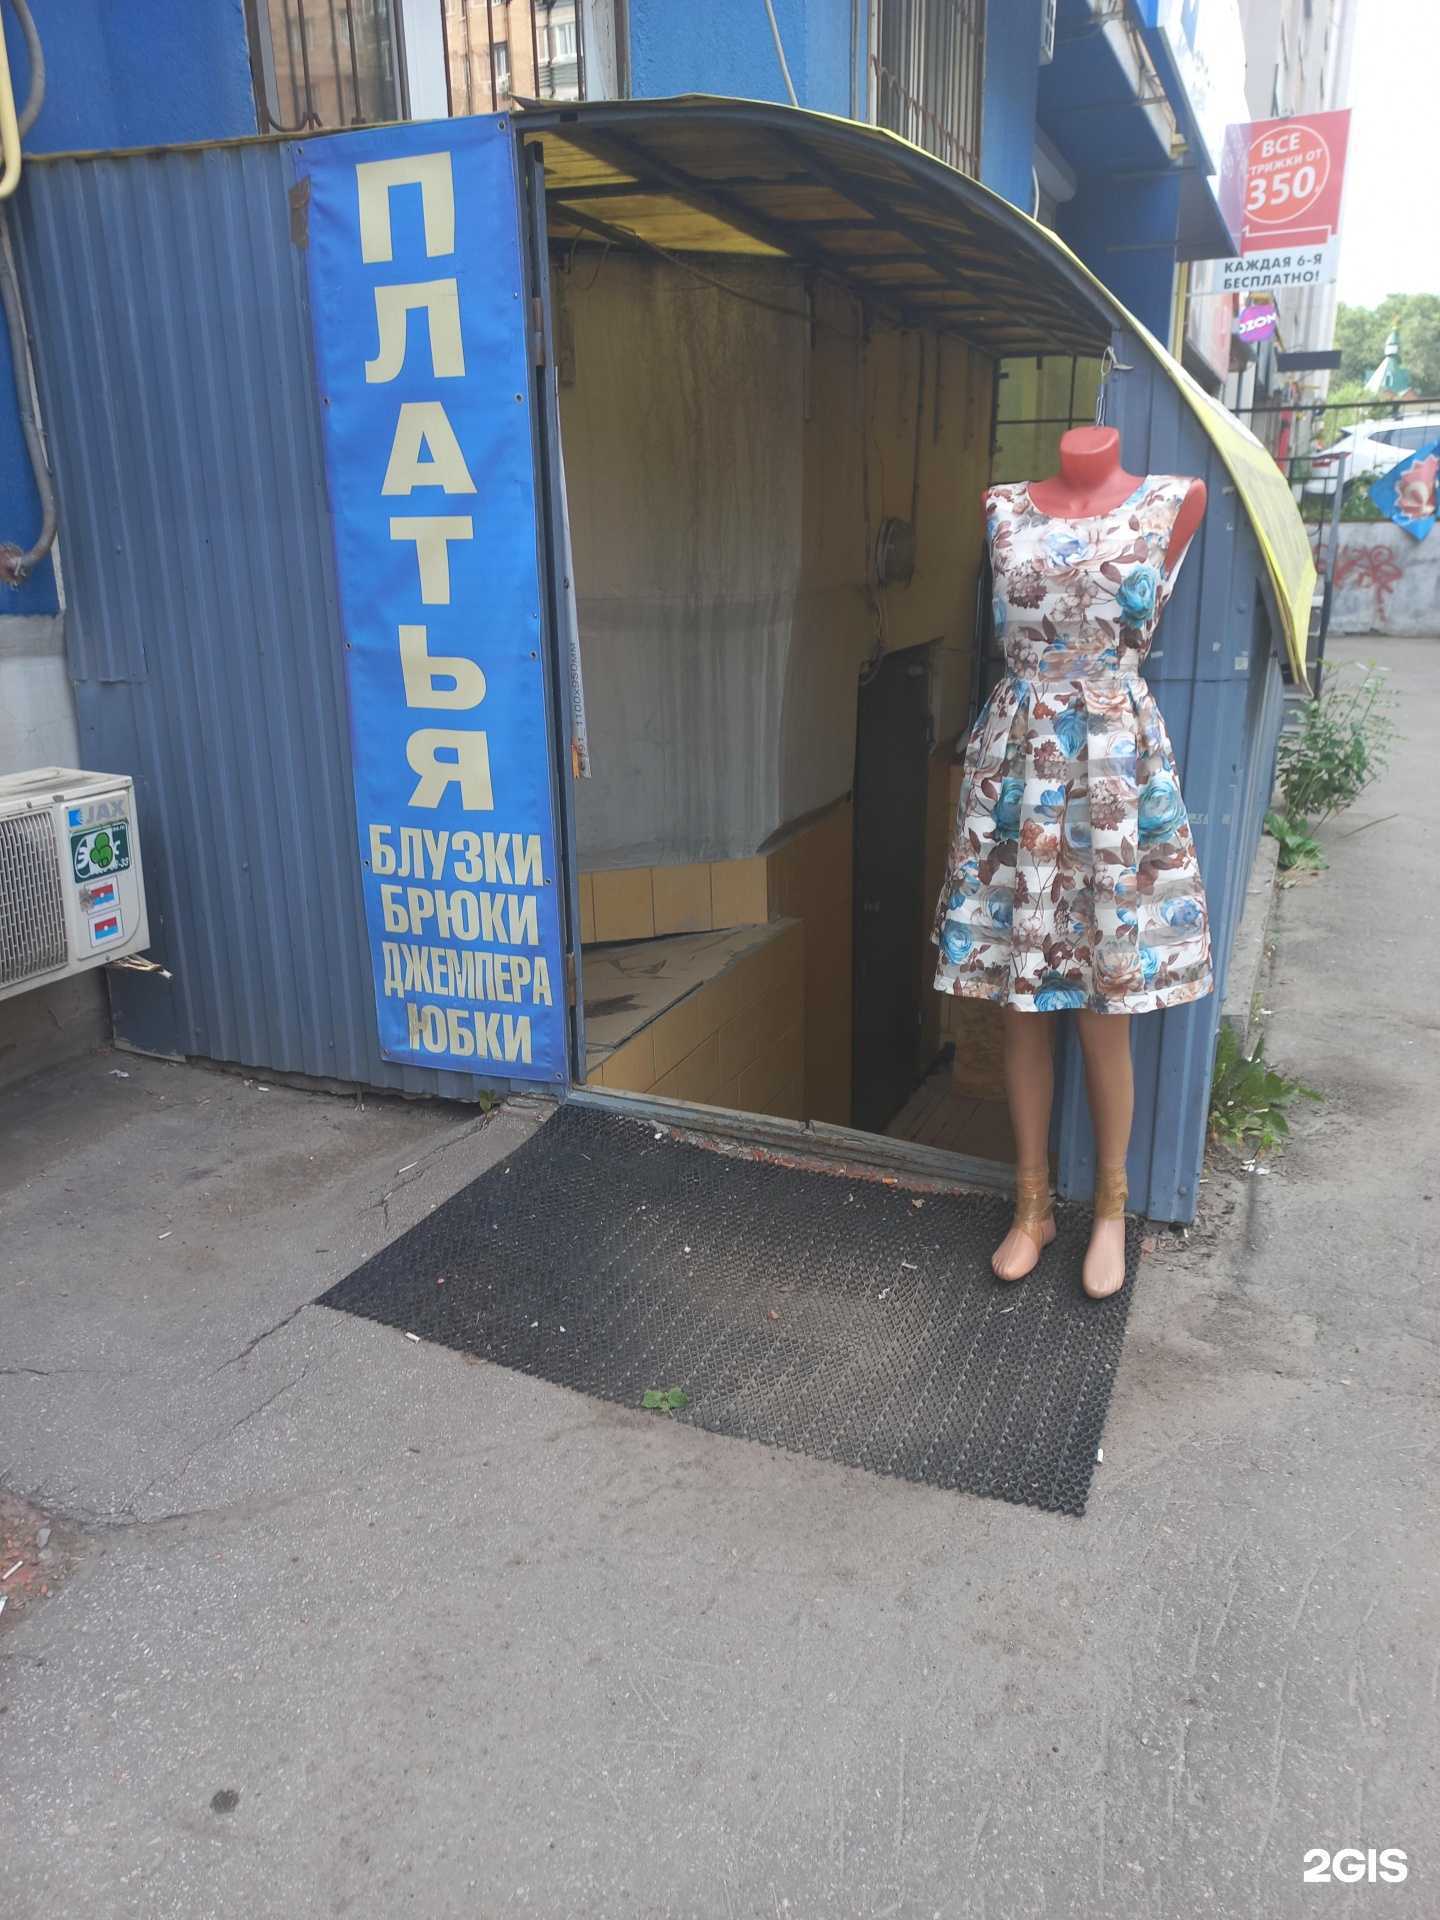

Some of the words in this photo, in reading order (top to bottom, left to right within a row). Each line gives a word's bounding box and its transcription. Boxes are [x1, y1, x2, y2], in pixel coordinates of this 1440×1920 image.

[1248, 153, 1303, 176] ТРИЖКИ
[1306, 148, 1323, 162] ОТ
[1261, 132, 1301, 158] ВСЕ
[1224, 256, 1291, 273] КАЖДАЯ
[1297, 253, 1323, 267] 6-Я
[1224, 270, 1320, 290] БЕСПЛАТНО!
[356, 151, 494, 811] ПЛАТЬЯ
[369, 824, 544, 886] БЛУЗКИ
[381, 884, 539, 945] БРЮКИ
[382, 941, 553, 1006] ДЖЕМПЕРА
[407, 1002, 532, 1064] ЮБКИ
